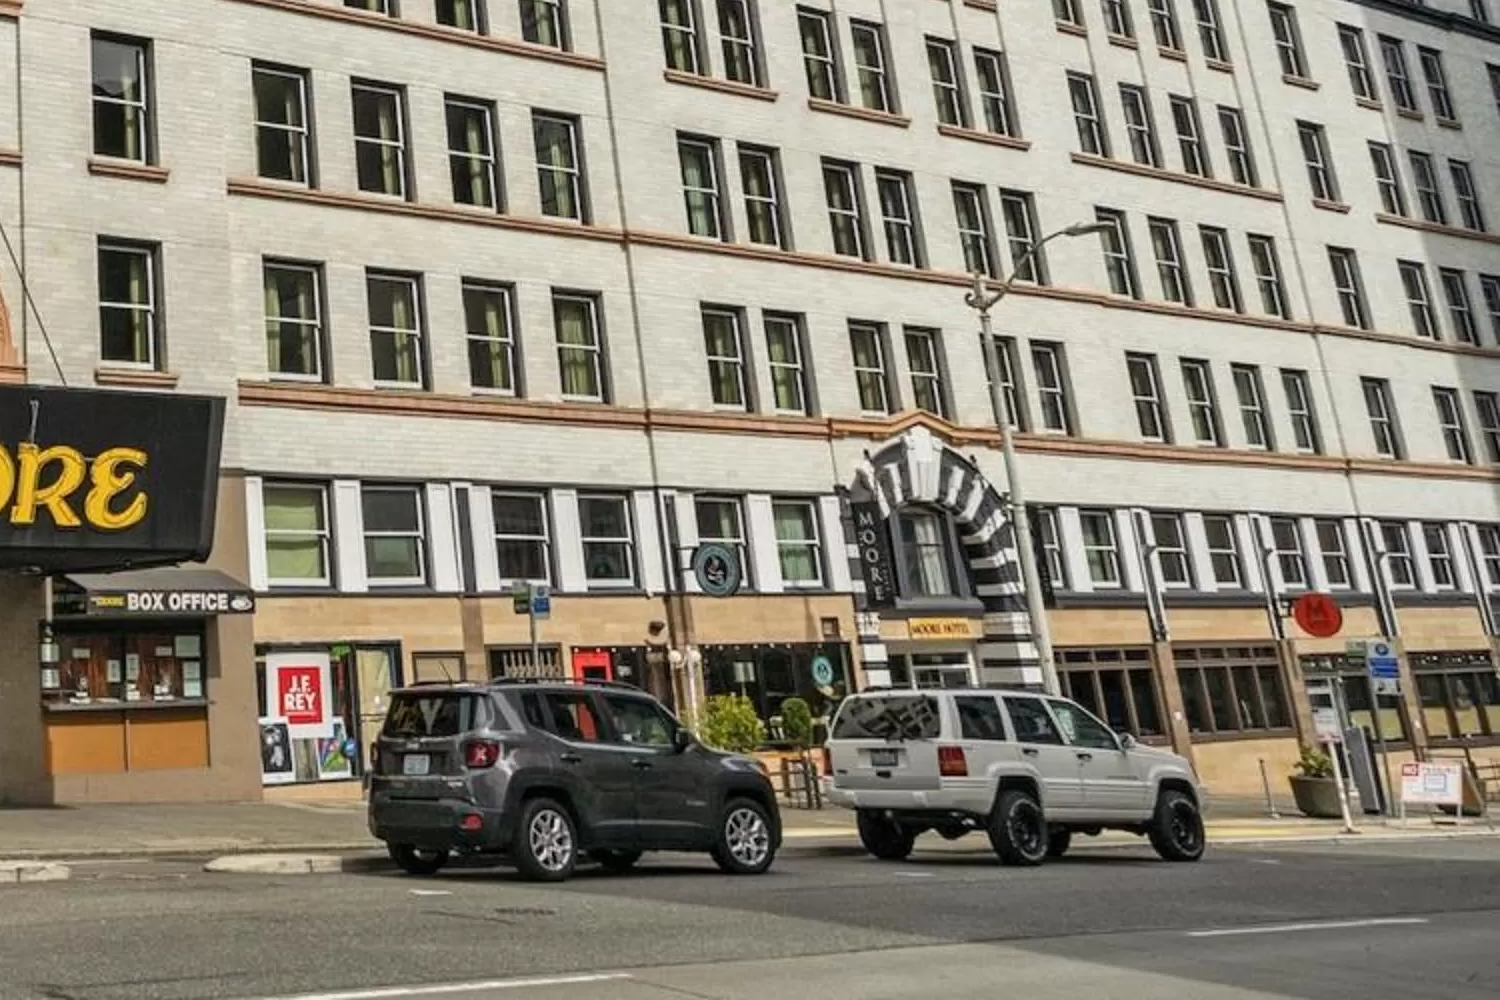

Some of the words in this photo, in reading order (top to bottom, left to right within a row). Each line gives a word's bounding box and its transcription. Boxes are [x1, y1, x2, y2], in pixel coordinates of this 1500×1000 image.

[858, 511, 885, 601] MOORE
[127, 592, 164, 611] BOX
[168, 592, 228, 611] OFFICE
[288, 674, 312, 693] J.F.
[283, 693, 316, 711] REY
